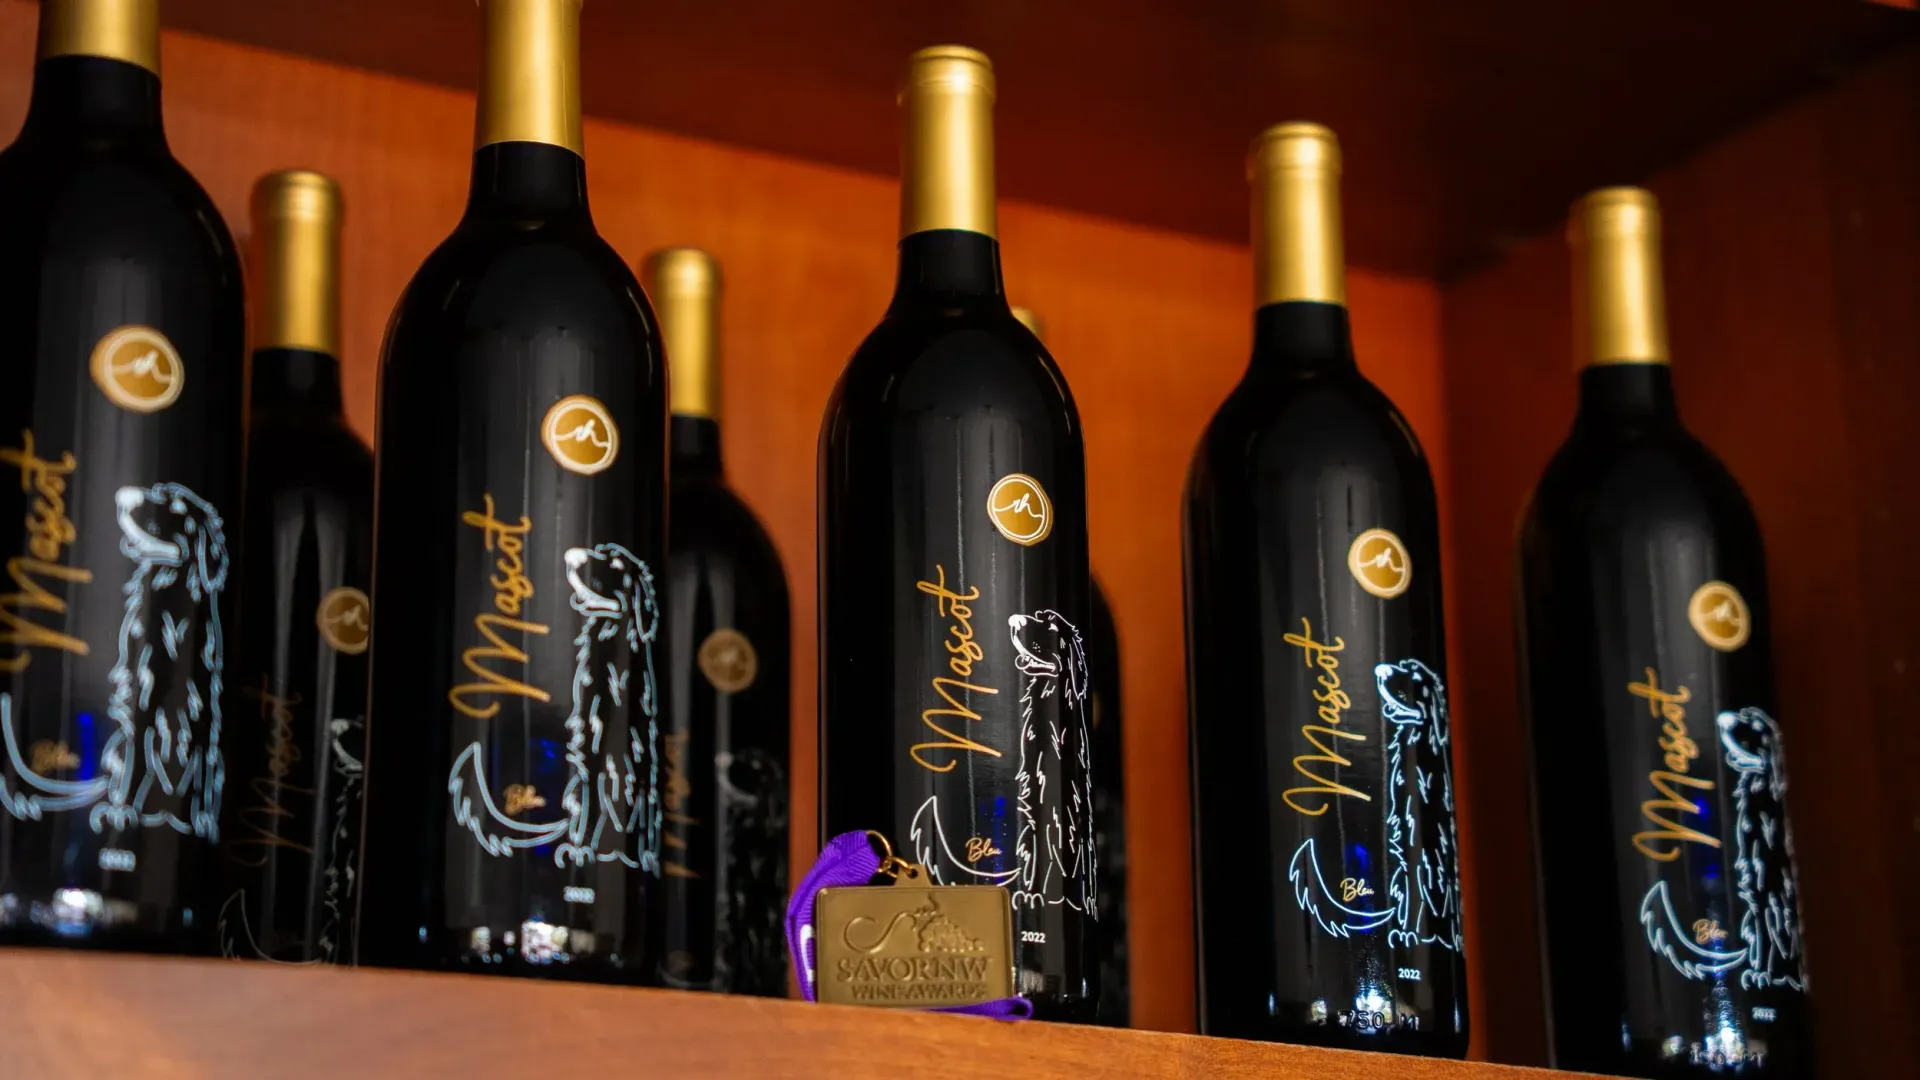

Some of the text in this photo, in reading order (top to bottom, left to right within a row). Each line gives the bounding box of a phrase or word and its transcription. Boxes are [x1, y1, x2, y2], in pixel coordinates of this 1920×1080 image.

[0, 429, 92, 672] Mascot
[448, 495, 549, 719] Mascot
[910, 565, 1001, 772] Mascot
[1283, 617, 1371, 816] Mascot
[1628, 667, 1722, 861] Mascot
[966, 838, 1002, 862] Bleu
[1021, 931, 1046, 943] 2022
[1340, 877, 1375, 902] Bleu
[1398, 968, 1421, 980] 2022
